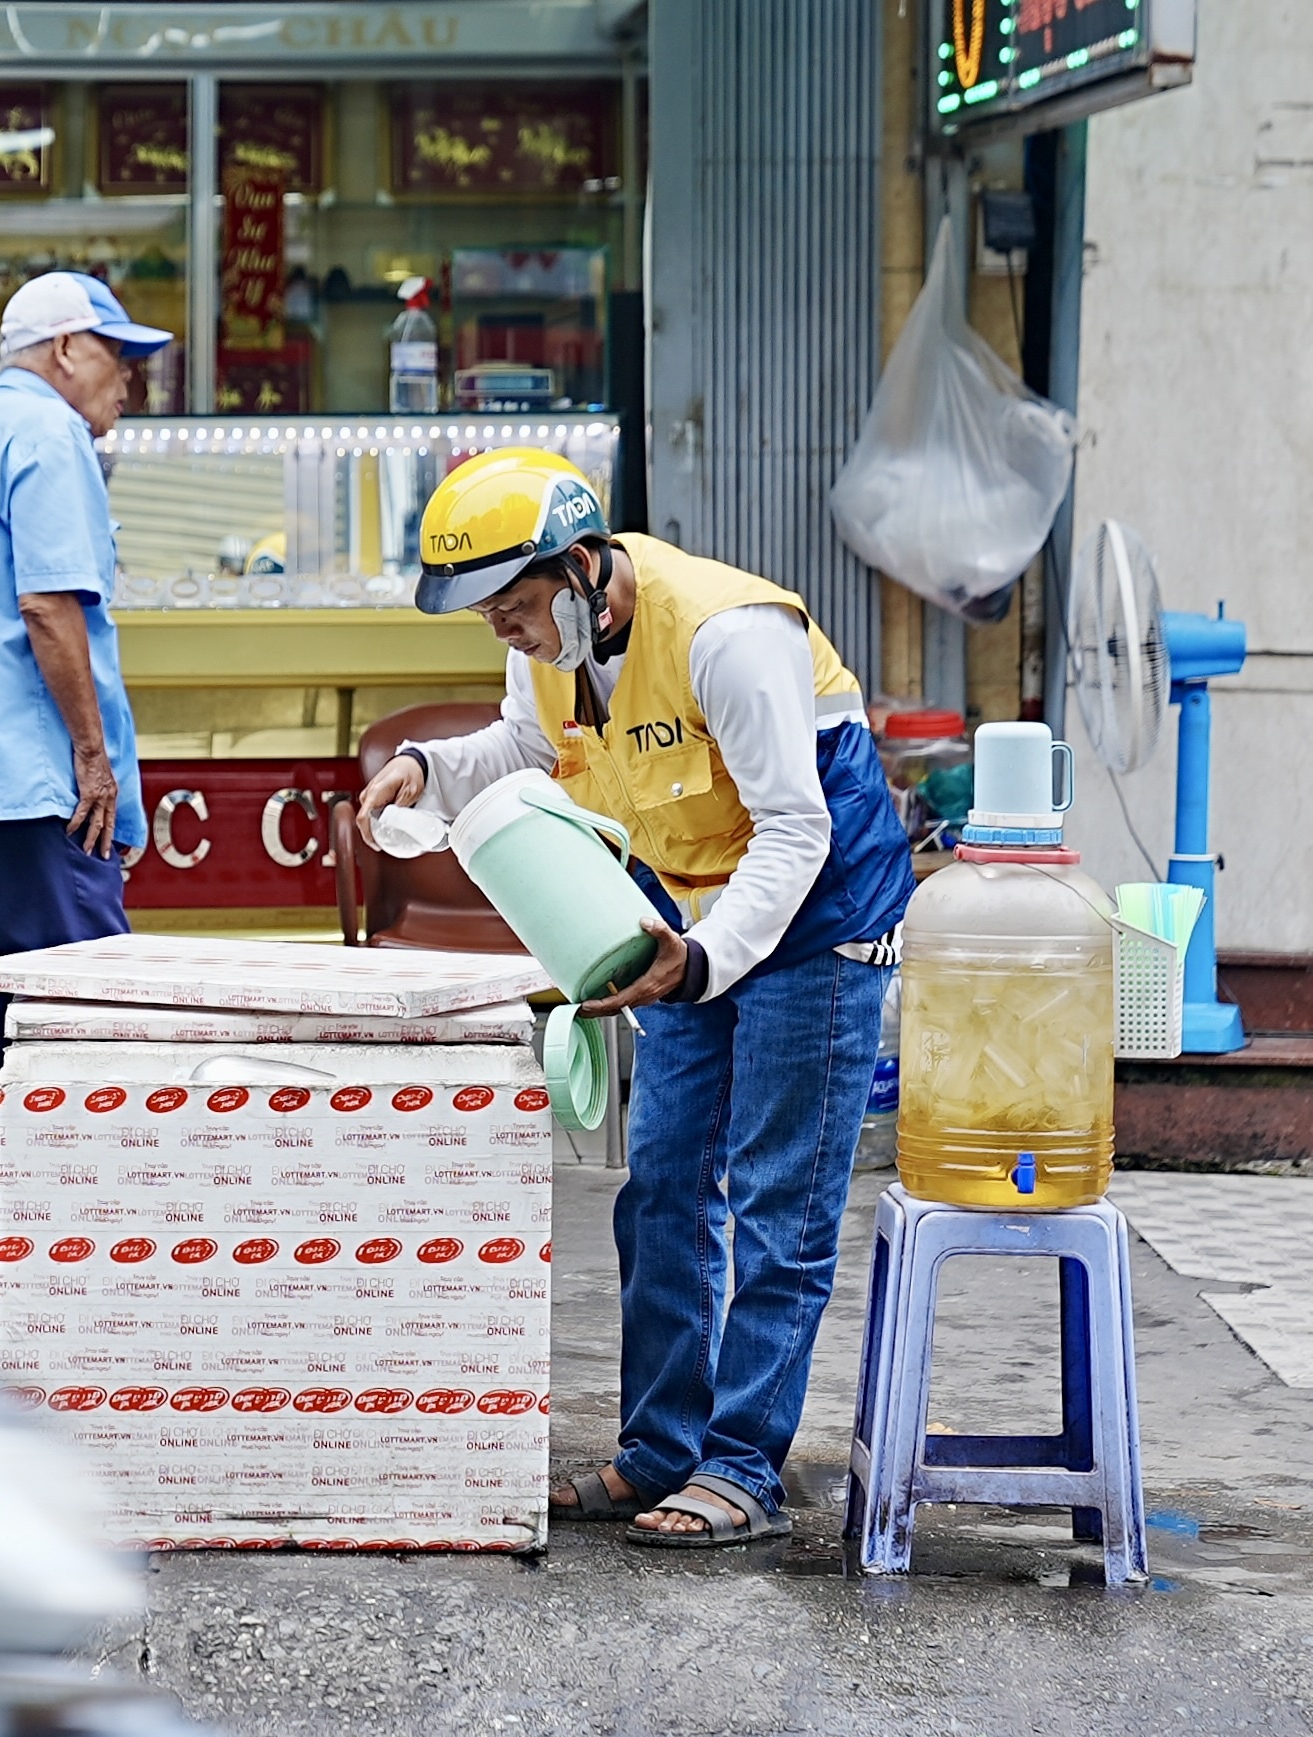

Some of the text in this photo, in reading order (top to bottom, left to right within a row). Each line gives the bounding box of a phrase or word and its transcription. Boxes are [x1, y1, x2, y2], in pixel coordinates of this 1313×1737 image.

[278, 7, 459, 49] CHÂU
[554, 492, 596, 527] TADA
[430, 532, 473, 553] TADA
[175, 1029, 230, 1038] LOTTEMART.VN
[35, 1133, 92, 1142] LOTTEMART.VN
[190, 1134, 247, 1142] LOTTEMART.VN
[344, 1133, 401, 1142] LOTTEMART.VN
[121, 1138, 160, 1148] ONLINE
[275, 1138, 314, 1148] ONLINE
[429, 1138, 468, 1148] ONLINE
[127, 1171, 184, 1180] LOTTEMART.VN
[281, 1171, 338, 1180] LOTTEMART.VN
[434, 1170, 491, 1178] LOTTEMART.VN
[60, 1175, 99, 1185] ONLINE
[214, 1176, 253, 1186] ONLINE
[367, 1175, 406, 1185] ONLINE
[520, 1176, 551, 1185] ONLIN
[13, 1211, 52, 1221] ONLINE
[80, 1208, 137, 1216] LOTTEMART.VN
[233, 1208, 290, 1216] LOTTEMART.VN
[386, 1208, 443, 1216] LOTTEMART.VN
[472, 1212, 511, 1222] ONLINE
[166, 1213, 205, 1223] ONLINE
[319, 1213, 358, 1223] ONLINE
[49, 1286, 88, 1296] ONLINE
[117, 1283, 174, 1292] LOTTEMART.VN
[271, 1284, 328, 1292] LOTTEMART.VN
[423, 1284, 480, 1292] LOTTEMART.VN
[202, 1288, 241, 1298] ONLINE
[356, 1289, 395, 1299] ONLINE
[509, 1290, 548, 1300] ONLINE
[27, 1324, 66, 1334] ONLINE
[94, 1320, 151, 1328] LOTTEMART.VN
[249, 1322, 306, 1330] LOTTEMART.VN
[401, 1322, 458, 1330] LOTTEMART.VN
[180, 1325, 219, 1335] ONLINE
[334, 1327, 373, 1337] ONLINE
[487, 1327, 526, 1337] ONLINE
[1, 1360, 40, 1370] ONLINE
[68, 1356, 125, 1364] LOTTEMART.VN
[223, 1358, 280, 1366] LOTTEMART.VN
[375, 1359, 432, 1368] LOTTEMART.VN
[154, 1361, 193, 1371] ONLINE
[308, 1363, 347, 1373] ONLINE
[461, 1364, 500, 1374] ONLINE
[74, 1432, 131, 1440] LOTTEMART.VN
[227, 1434, 284, 1442] LOTTEMART.VN
[380, 1436, 437, 1444] LOTTEMART.VN
[160, 1438, 199, 1448] ONLINE
[313, 1440, 352, 1450] ONLINE
[467, 1441, 506, 1451] ONLINE
[158, 1475, 197, 1485] ONLINE
[225, 1472, 282, 1480] LOTTEMART.VN
[378, 1473, 435, 1482] LOTTEMART.VN
[312, 1477, 351, 1487] ONLINE
[465, 1479, 504, 1489] ONLINE
[396, 1511, 453, 1520] LOTTEMART.VN
